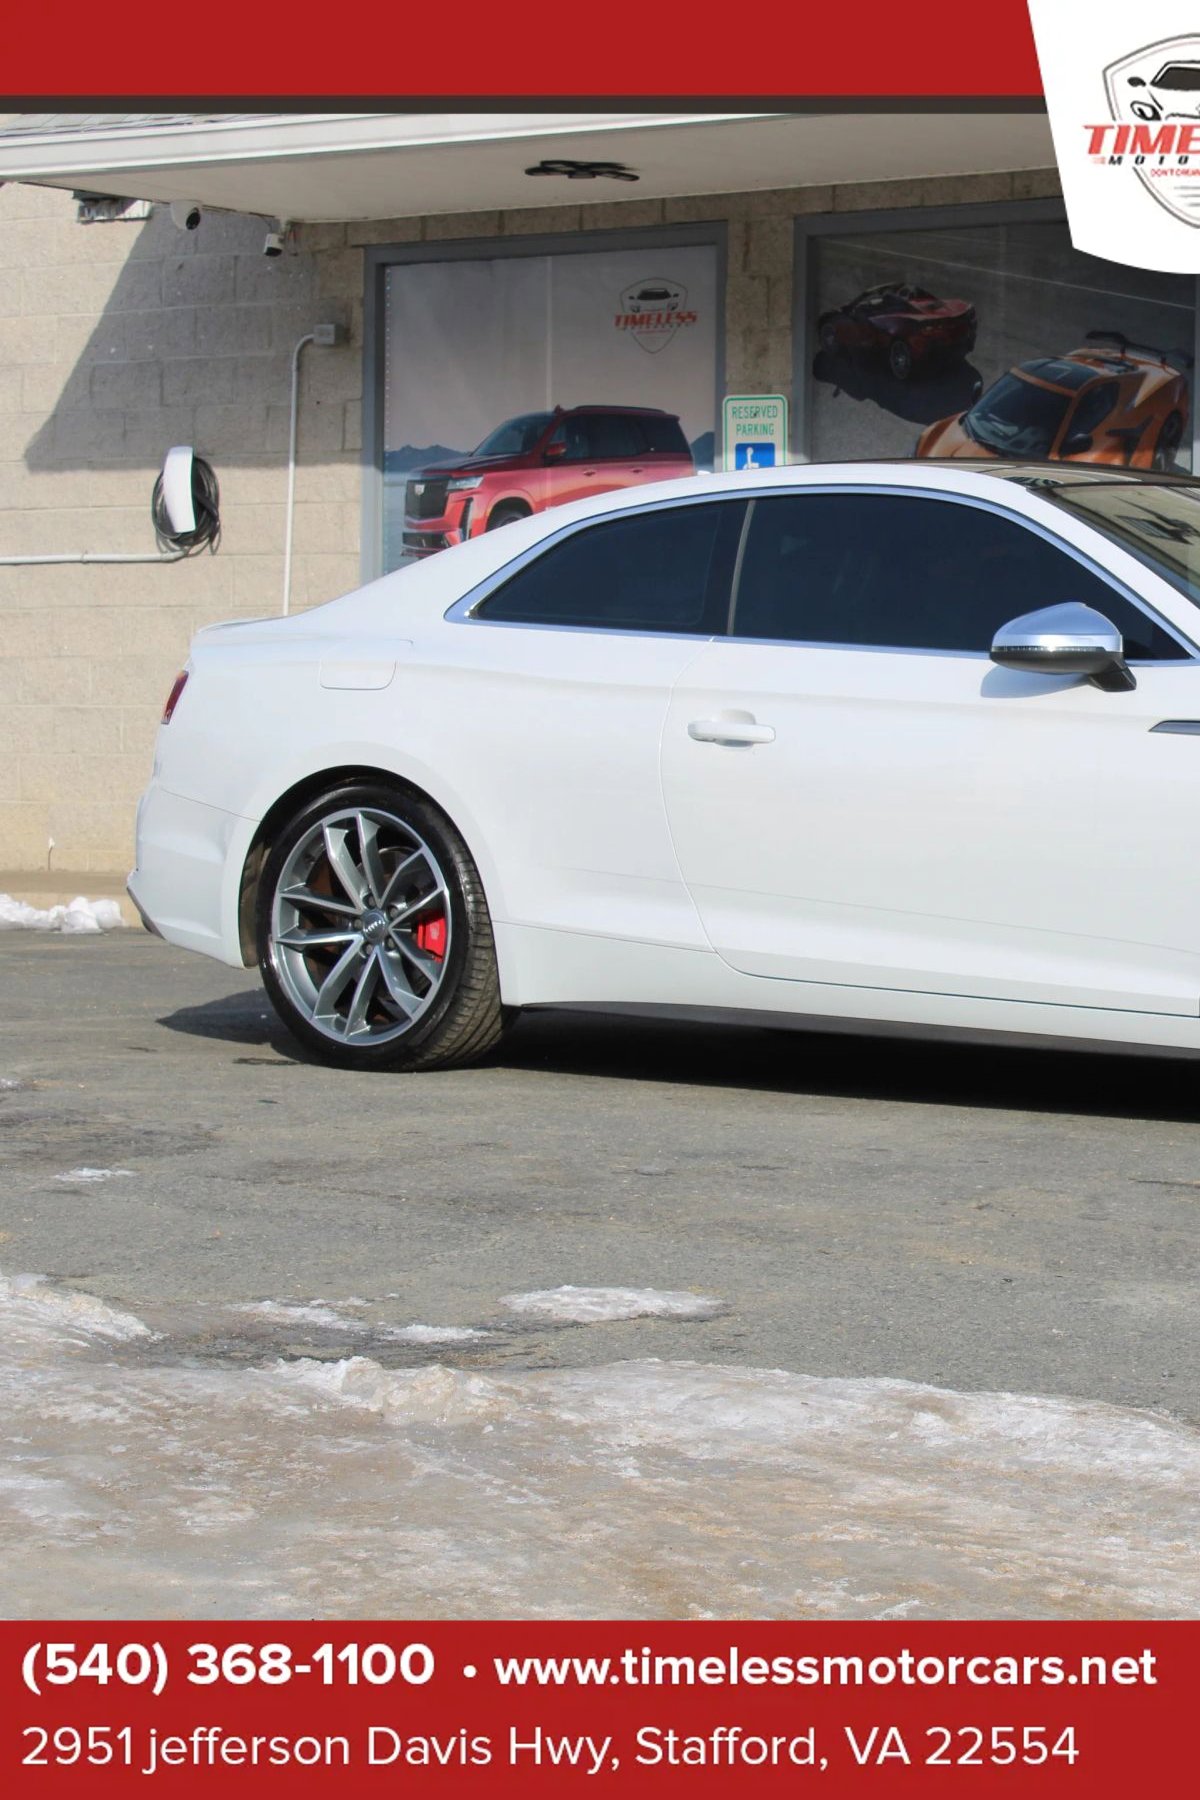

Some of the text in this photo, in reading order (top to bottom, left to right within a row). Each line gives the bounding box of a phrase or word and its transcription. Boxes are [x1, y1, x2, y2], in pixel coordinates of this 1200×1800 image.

[613, 310, 698, 327] TIMELESS
[732, 405, 777, 419] RESERVED
[736, 423, 774, 436] PARKING
